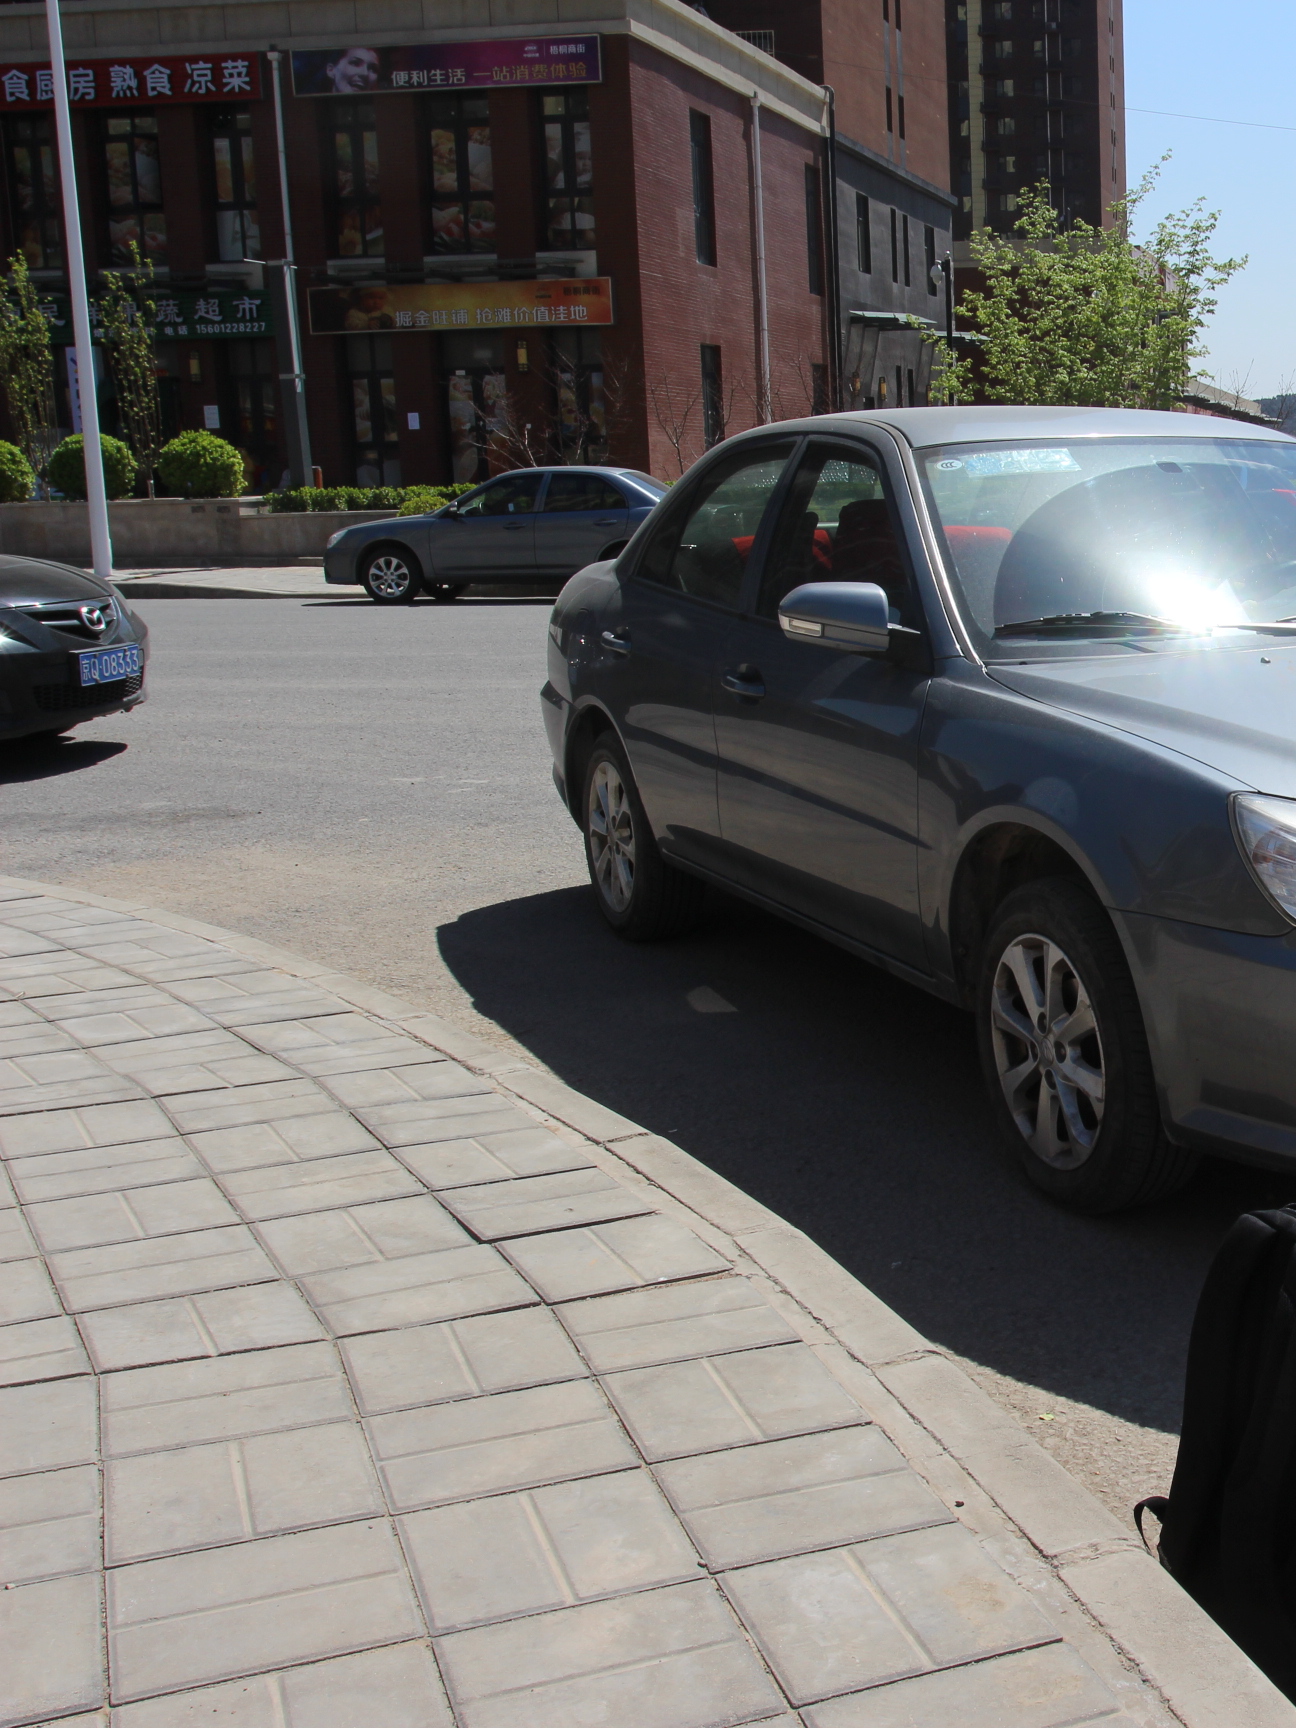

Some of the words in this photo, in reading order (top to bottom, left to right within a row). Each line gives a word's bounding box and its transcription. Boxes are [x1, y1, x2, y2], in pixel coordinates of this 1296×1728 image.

[109, 63, 173, 98] 熟食
[184, 59, 251, 94] 凉菜
[390, 68, 466, 88] 便利生活
[473, 61, 588, 81] 一站消费体验
[394, 308, 469, 327] 掘金旺铺
[476, 304, 588, 324] 抢滩价值洼地
[164, 324, 188, 336] 电话
[195, 322, 266, 334] 15601228227
